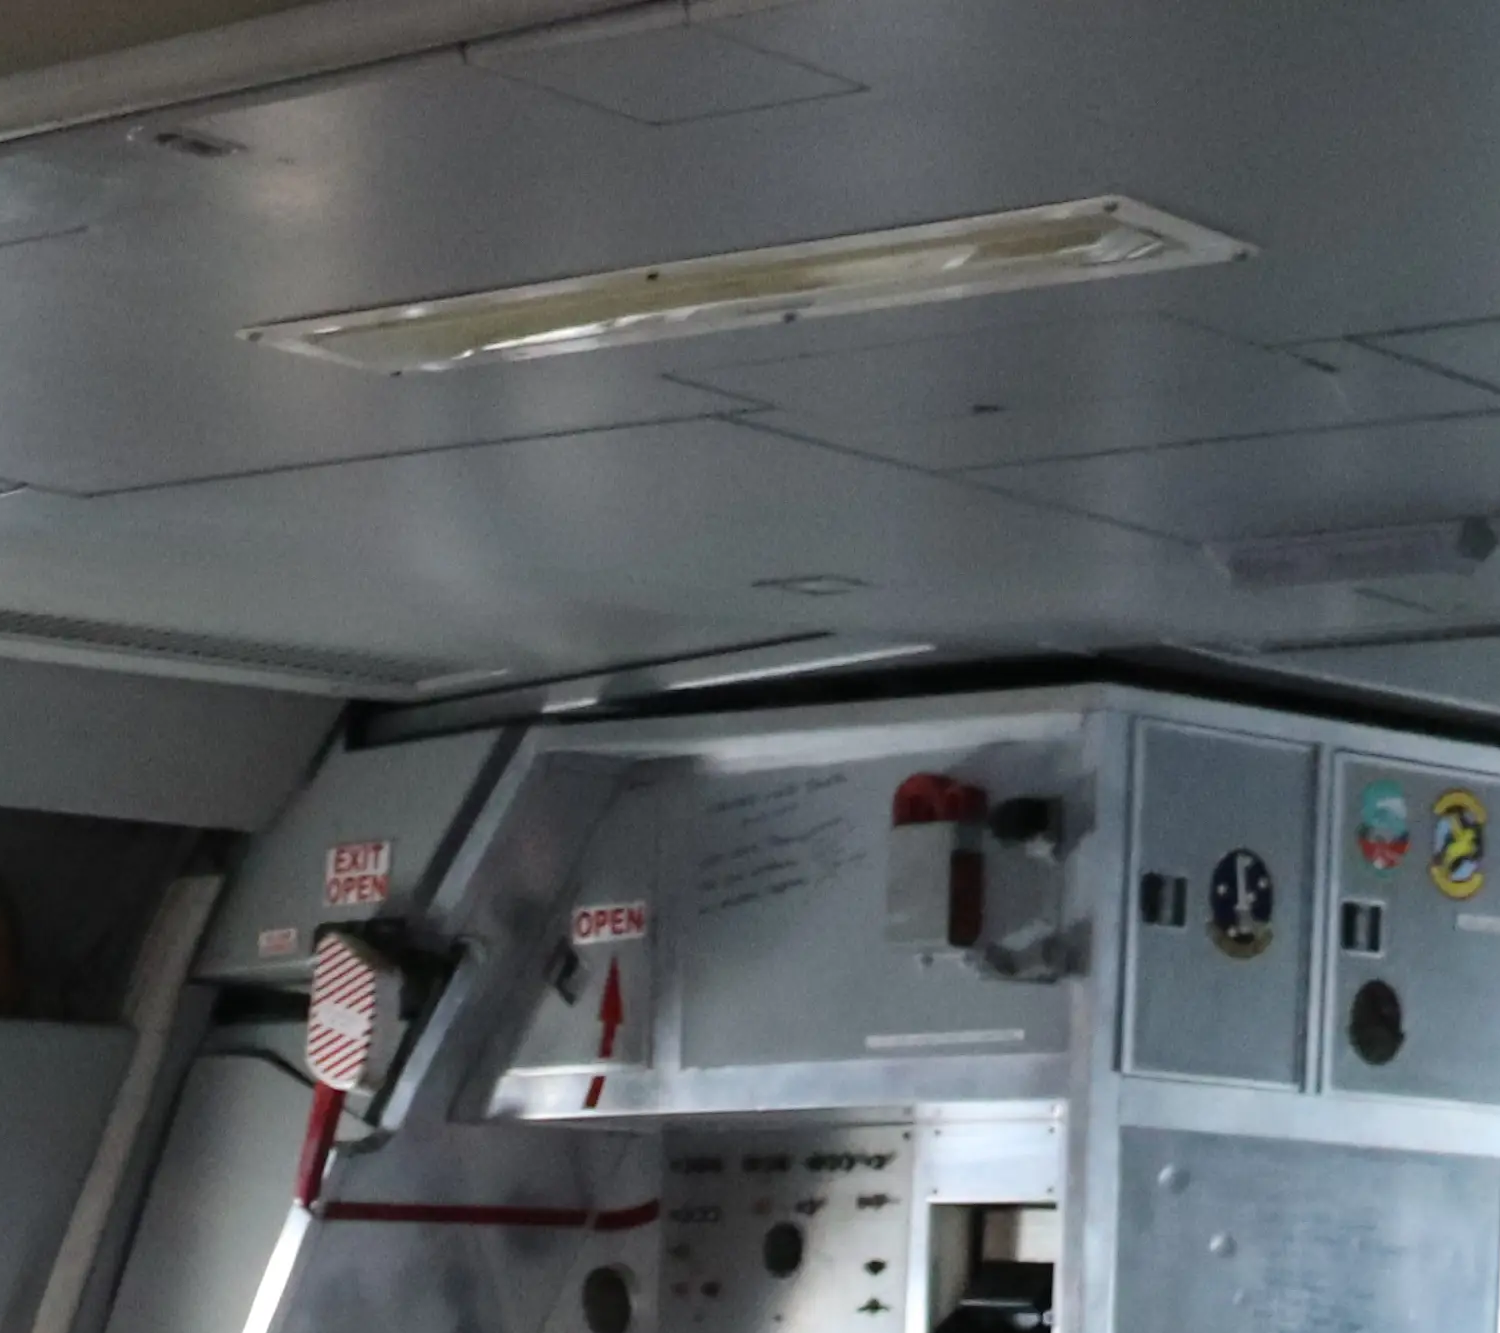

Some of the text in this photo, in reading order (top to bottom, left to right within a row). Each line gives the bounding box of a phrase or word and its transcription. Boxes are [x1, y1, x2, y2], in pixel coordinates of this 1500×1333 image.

[334, 844, 384, 872] EXIT
[327, 875, 389, 903] OPEN
[576, 907, 645, 938] OPEN
